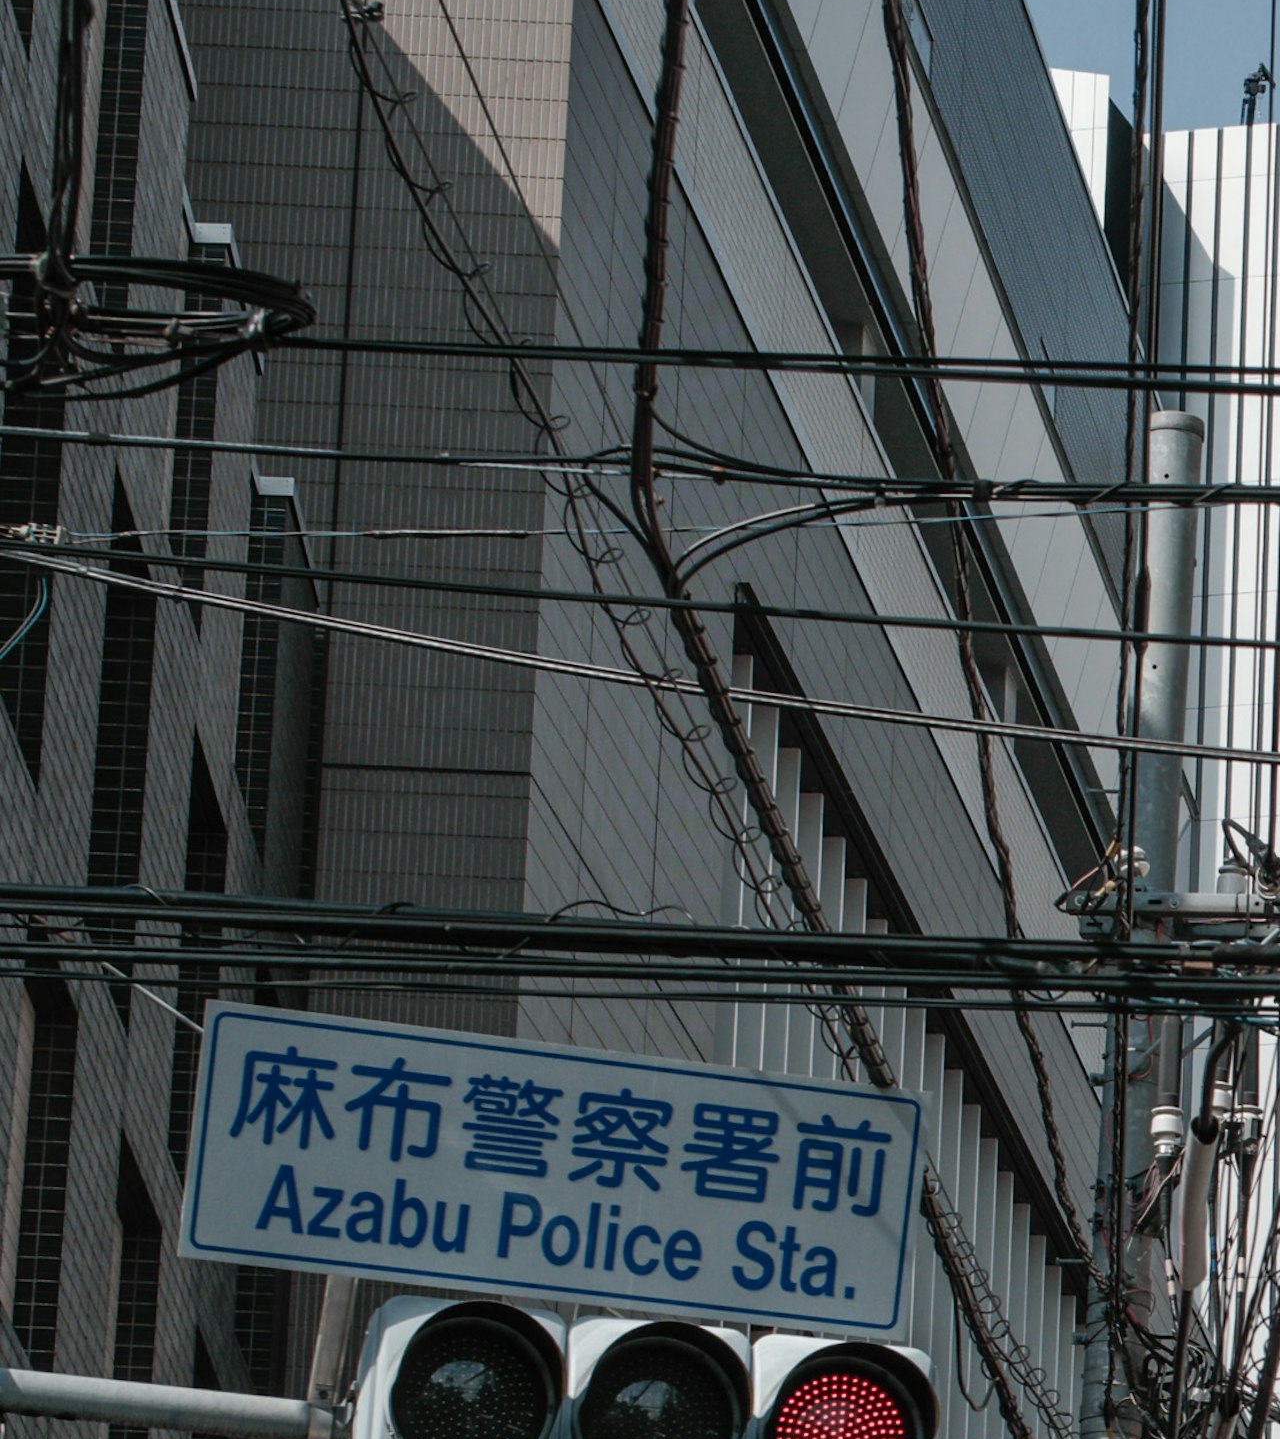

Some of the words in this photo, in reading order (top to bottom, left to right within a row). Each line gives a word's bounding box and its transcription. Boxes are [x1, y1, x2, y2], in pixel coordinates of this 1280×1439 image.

[229, 1046, 893, 1218] 麻布警察署前
[256, 1164, 468, 1255] Azabu
[497, 1192, 703, 1281] Police
[732, 1219, 856, 1300] Sta.
